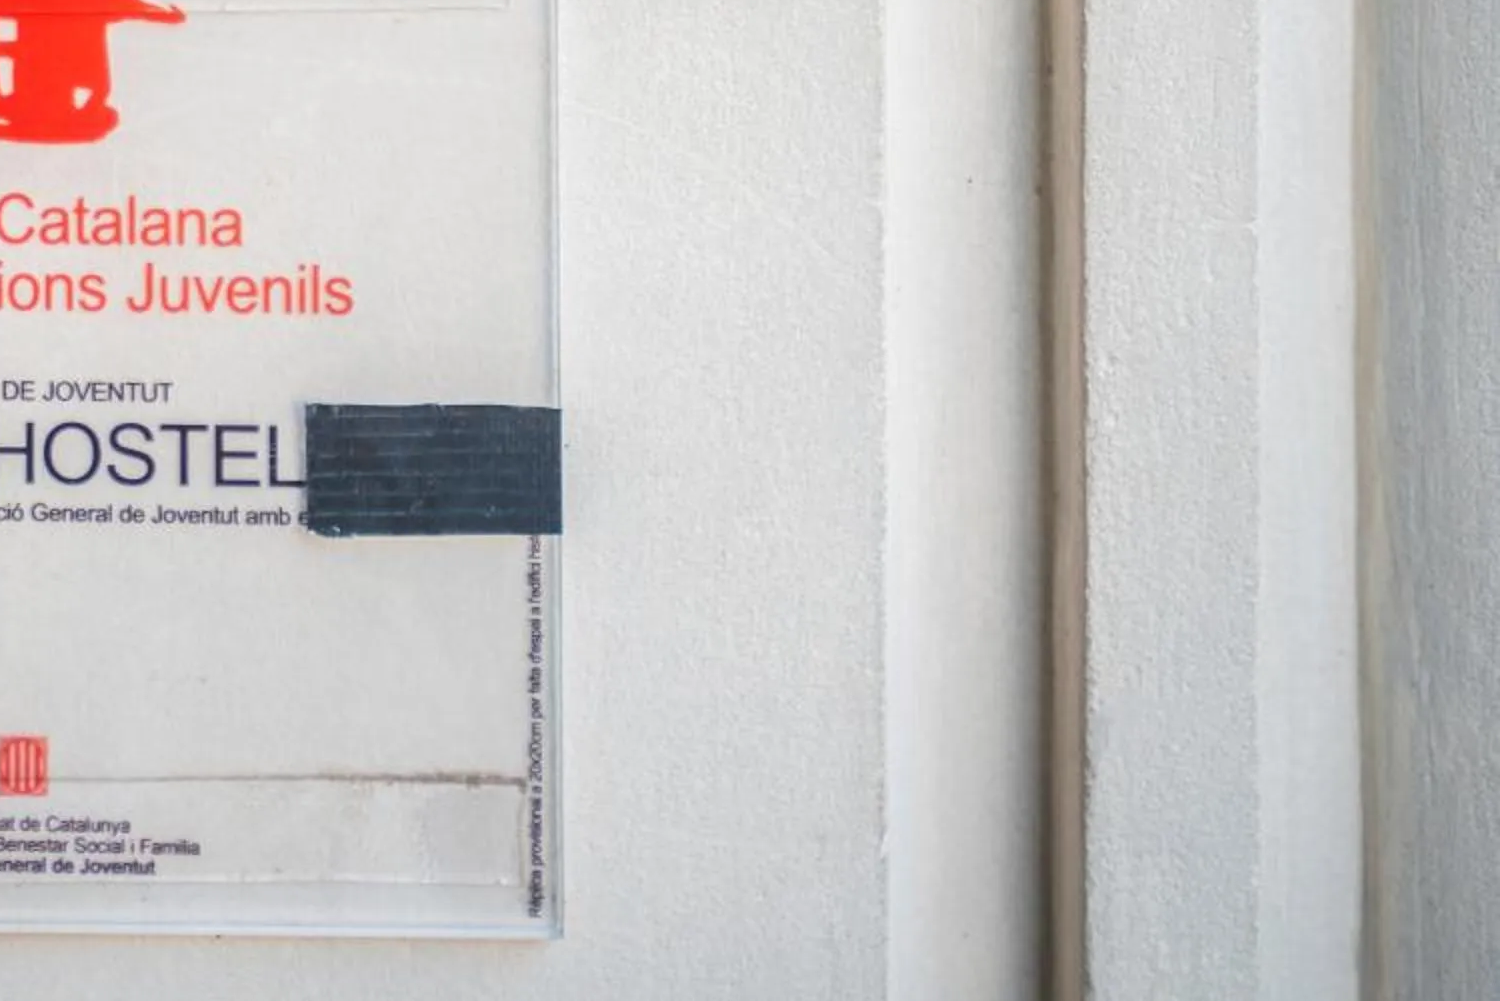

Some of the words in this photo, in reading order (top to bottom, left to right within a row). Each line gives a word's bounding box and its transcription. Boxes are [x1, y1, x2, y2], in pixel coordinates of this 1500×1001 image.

[128, 263, 353, 316] Juvenils
[2, 380, 35, 402] DE
[42, 381, 173, 403] JOVENTUT
[30, 503, 113, 524] General
[118, 504, 145, 524] de
[151, 504, 240, 526] Joventut
[245, 506, 292, 526] amb
[19, 815, 41, 831] de
[45, 815, 131, 836] Catalunya
[75, 837, 125, 854] Social
[52, 858, 74, 874] de
[80, 859, 155, 875] Joventut
